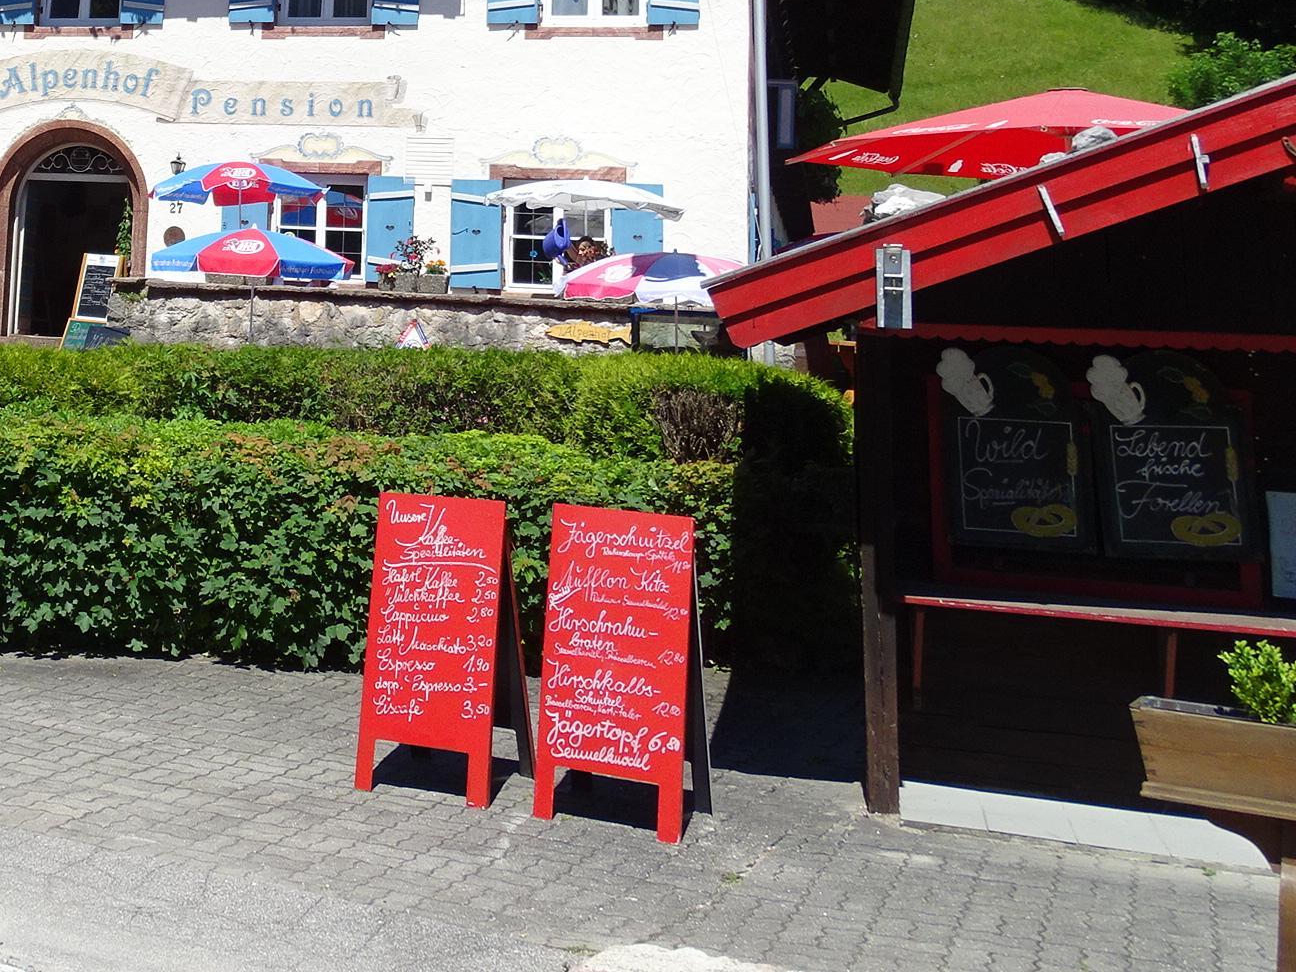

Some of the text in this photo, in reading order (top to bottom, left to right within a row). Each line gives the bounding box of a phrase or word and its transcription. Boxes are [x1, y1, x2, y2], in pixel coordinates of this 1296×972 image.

[190, 87, 374, 118] Pension
[169, 202, 184, 215] 27
[965, 418, 1049, 462] Wild
[1115, 429, 1213, 458] Lebend
[385, 499, 428, 524] Unsere
[1115, 479, 1227, 519] Forellen
[568, 631, 618, 652] braten
[376, 649, 436, 679] Espresso
[404, 674, 461, 702] Espresso
[544, 709, 649, 753] Jägertopf
